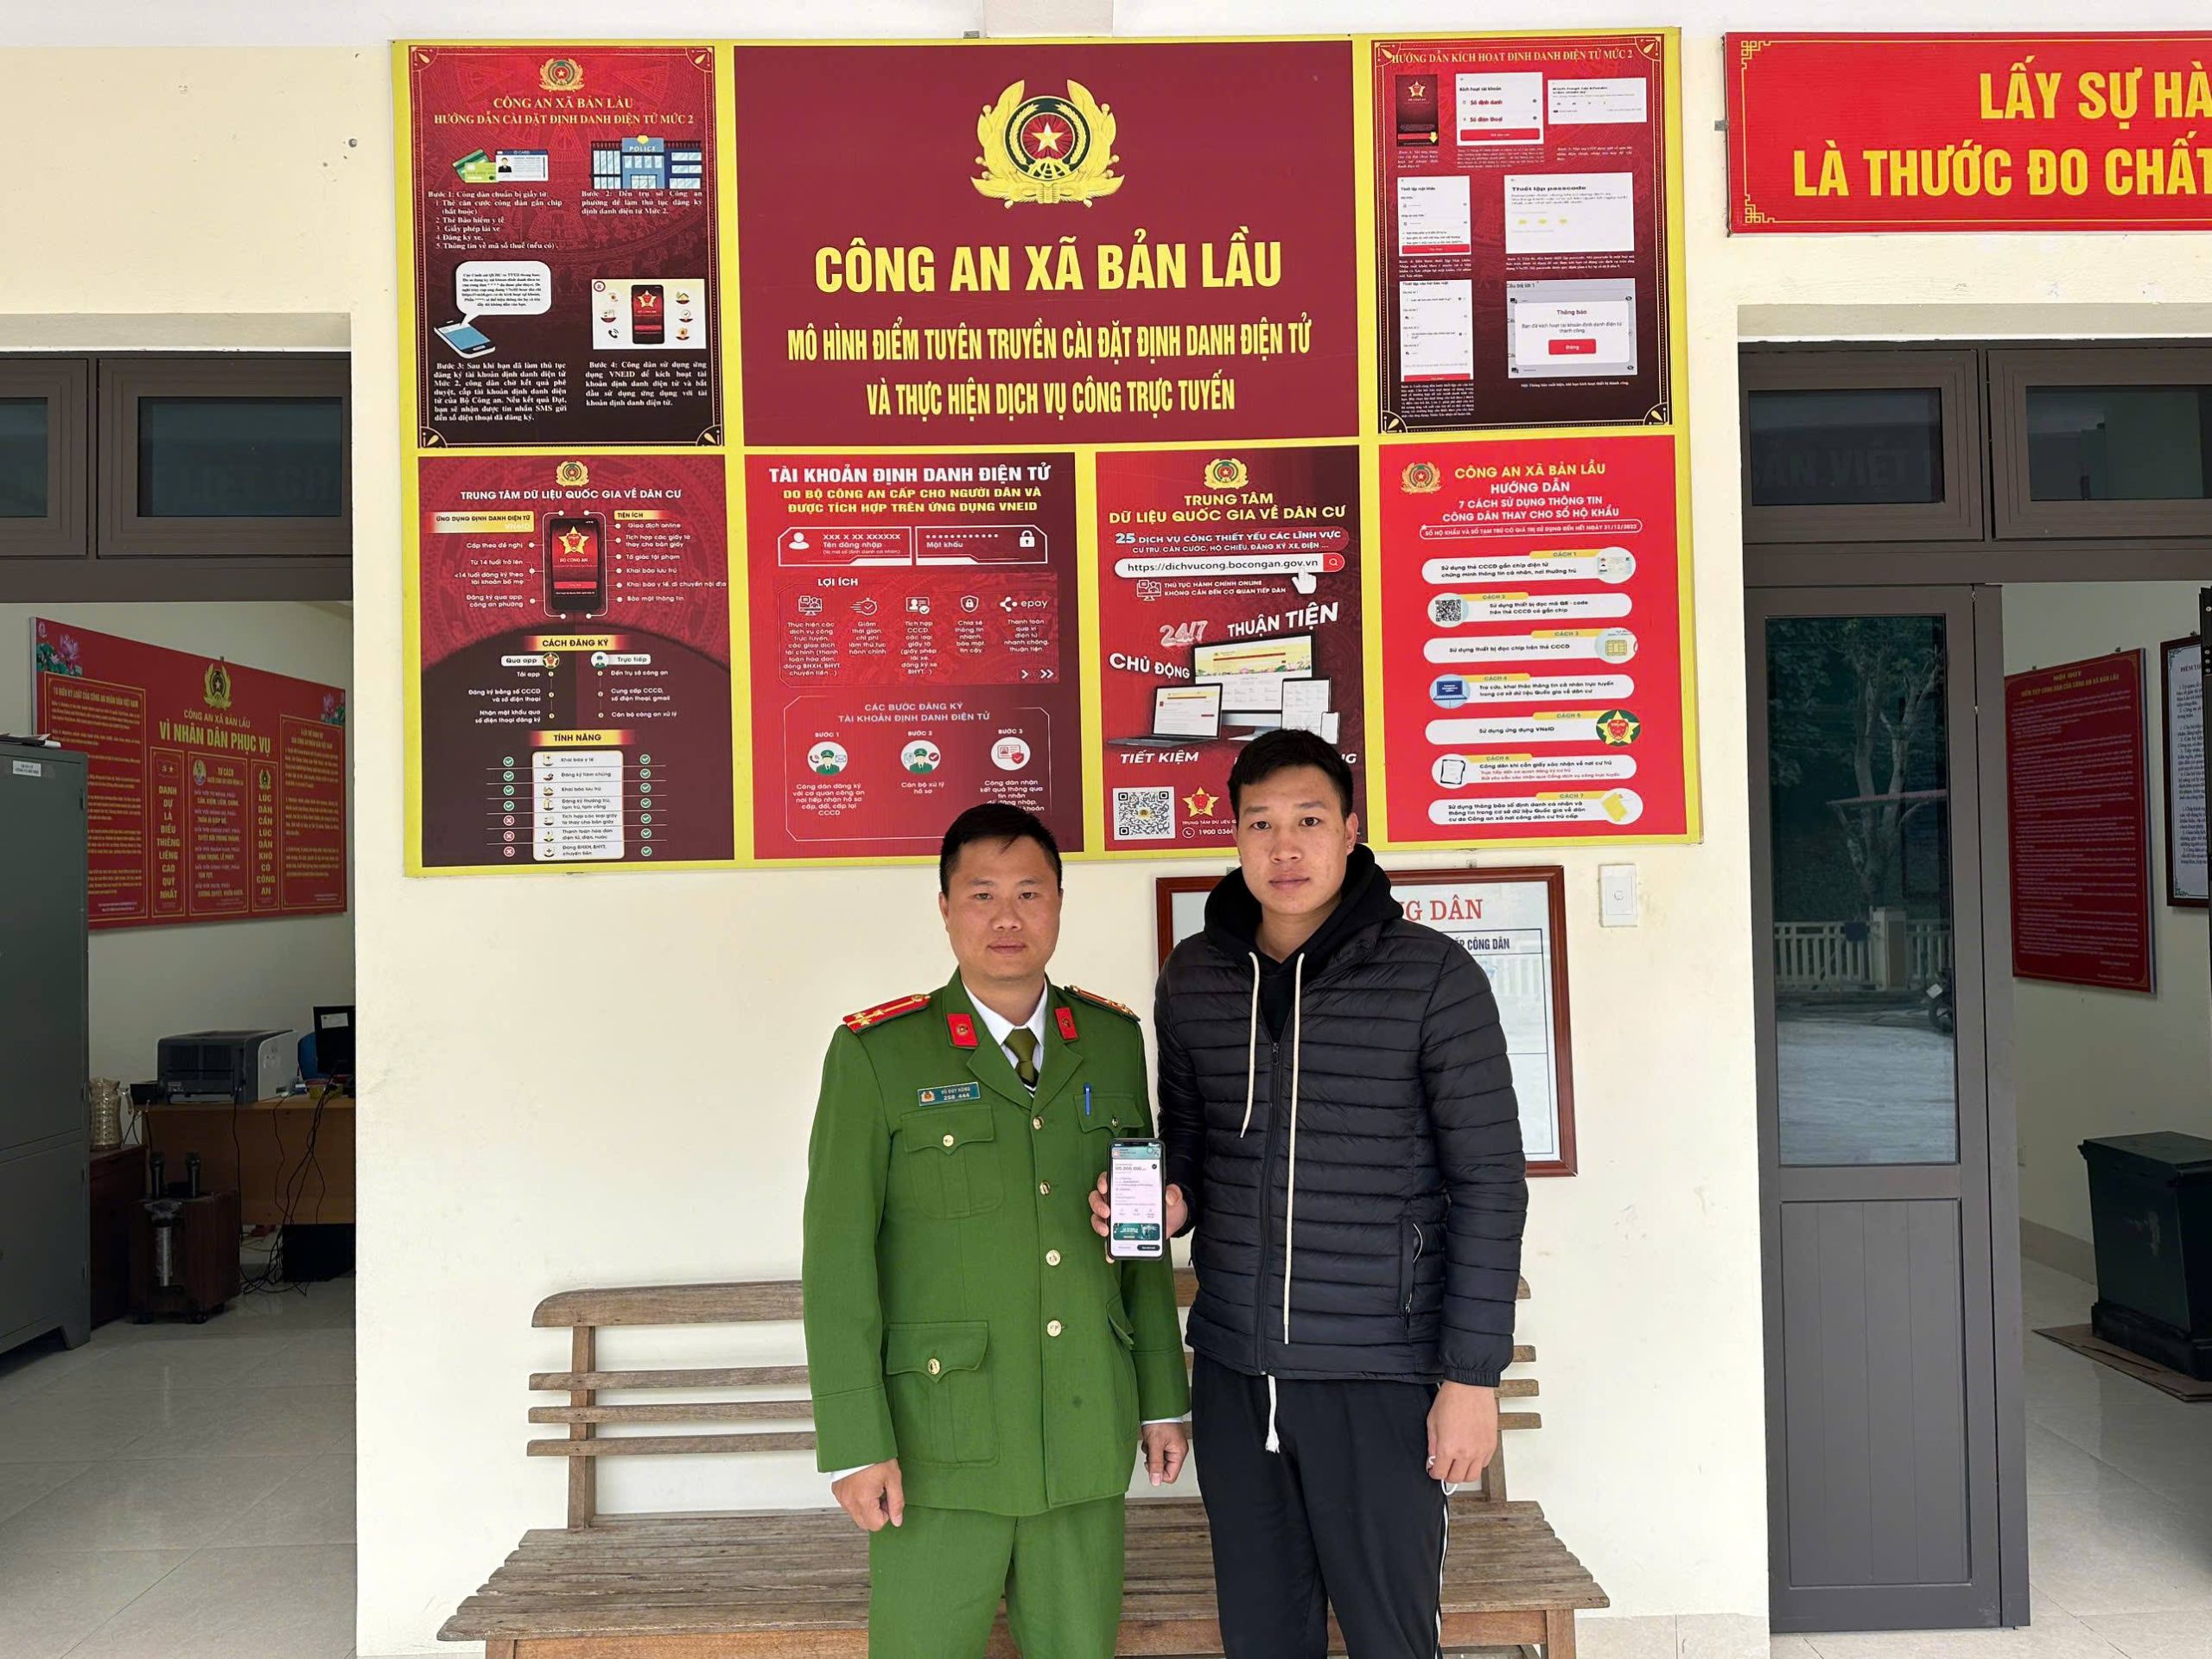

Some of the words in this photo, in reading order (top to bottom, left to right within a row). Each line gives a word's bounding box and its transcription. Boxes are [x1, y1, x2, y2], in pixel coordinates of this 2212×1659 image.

[1980, 54, 2063, 119] LẤY
[2076, 65, 2142, 129] SỰ
[1792, 139, 1850, 197] LÀ
[1863, 137, 2012, 197] THƯỚC
[2027, 147, 2088, 195] ĐO
[814, 237, 934, 292] CÔNG
[950, 245, 1010, 291] AN
[1025, 236, 1084, 290] XÃ
[1097, 228, 1185, 289] BẢN
[1202, 226, 1281, 287] LẦU
[787, 322, 817, 360] MÔ
[823, 322, 867, 359] HÌNH
[872, 316, 918, 359] ĐIỂM
[924, 321, 982, 359] TUYÊN
[987, 317, 1056, 359] TRUYỀN
[1062, 321, 1092, 359] CÀI
[1097, 320, 1131, 363] ĐẶT
[1136, 325, 1180, 362] ĐỊNH
[1186, 324, 1235, 355] DANH
[1240, 316, 1282, 360] ĐIỆN
[1287, 311, 1312, 353] TỬ
[866, 377, 891, 415] VÀ
[895, 380, 942, 422] THỰC
[948, 377, 990, 421] HIỆN
[995, 383, 1038, 421] DỊCH
[1043, 382, 1066, 420] VỤ
[1072, 375, 1122, 413] CÔNG
[1126, 377, 1173, 418] TRỰC
[1178, 369, 1235, 410] TUYẾN
[769, 466, 798, 482] TÀI
[804, 464, 867, 482] KHOẢN
[873, 467, 917, 485] ĐỊNH
[924, 467, 972, 481] DANH
[978, 462, 1021, 484] ĐIỆN
[1025, 461, 1051, 480] TỬ
[1454, 465, 1497, 479] CÔNG
[1502, 466, 1520, 477] AN
[1525, 463, 1544, 476] XÃ
[1548, 461, 1576, 475] BẢN
[1580, 459, 1605, 474] LẦU
[783, 490, 800, 499] DO
[805, 488, 823, 499] BỘ
[827, 487, 862, 499] CÔNG
[867, 489, 885, 498] AN
[889, 486, 915, 498] CẤP
[919, 489, 945, 498] CHO
[950, 486, 989, 497] NGƯỜI
[994, 486, 1020, 497] DÂN
[1023, 485, 1041, 497] VÀ
[1491, 480, 1538, 493] HƯỚNG
[1542, 477, 1569, 492] DẪN
[461, 491, 496, 499] TRUNG
[498, 489, 520, 499] TÂM
[524, 489, 538, 499] DỮ
[541, 489, 562, 500] LIỆU
[565, 487, 598, 499] QUỐC
[601, 490, 621, 499] GIA
[623, 487, 637, 498] VỀ
[639, 488, 662, 498] DÂN
[665, 489, 681, 498] CƯ
[1184, 493, 1237, 505] TRUNG
[1241, 491, 1274, 505] TÂM
[788, 503, 823, 514] ĐƯỢC
[827, 502, 856, 512] TÍCH
[861, 502, 887, 513] HỢP
[891, 501, 924, 512] TRÊN
[928, 501, 955, 512] ỨNG
[959, 501, 995, 513] DỤNG
[998, 500, 1037, 512] VNEID
[1467, 498, 1497, 508] CÁCH
[1501, 496, 1514, 507] SỬ
[1516, 498, 1545, 508] DỤNG
[1548, 496, 1584, 506] THÔNG
[1109, 510, 1131, 523] DỮ
[1136, 509, 1166, 524] LIỆU
[1172, 507, 1221, 521] QUỐC
[1226, 509, 1255, 520] GIA
[1259, 505, 1278, 519] VỀ
[1283, 505, 1316, 518] DÂN
[1320, 503, 1345, 517] CƯ
[1442, 512, 1474, 522] CÔNG
[1477, 511, 1498, 520] DÂN
[1501, 511, 1526, 519] THAY
[1529, 510, 1553, 519] CHO
[1555, 507, 1568, 518] SỔ
[1573, 508, 1588, 519] HỘ
[1591, 506, 1619, 518] KHẨU
[1115, 532, 1135, 543] 25
[1138, 536, 1163, 544] DỊCH
[1215, 531, 1243, 541] THIẾT
[1246, 531, 1266, 540] YẾU
[1319, 530, 1340, 539] VỰC
[1128, 560, 1318, 573] https://dichvucong.bocongan.gov.vn
[817, 577, 835, 588] LỢI
[838, 576, 858, 586] ÍCH
[1020, 600, 1047, 608] epay
[1227, 613, 1279, 637] THUẬN
[1285, 601, 1338, 630] TIỆN
[1109, 652, 1149, 672] CHỦ
[1154, 662, 1191, 678] ĐỘNG
[159, 718, 170, 741] VÌ
[174, 722, 204, 745] NHÂN
[207, 726, 228, 748] DÂN
[231, 732, 257, 755] PHỤC
[258, 736, 270, 758] VỤ
[553, 733, 573, 741] TÍNH
[1120, 750, 1154, 763] TIẾT
[1158, 749, 1198, 764] KIỆM
[1430, 893, 1483, 920] DÂN
[1468, 936, 1491, 950] CÔNG
[1492, 936, 1510, 950] DÂN
